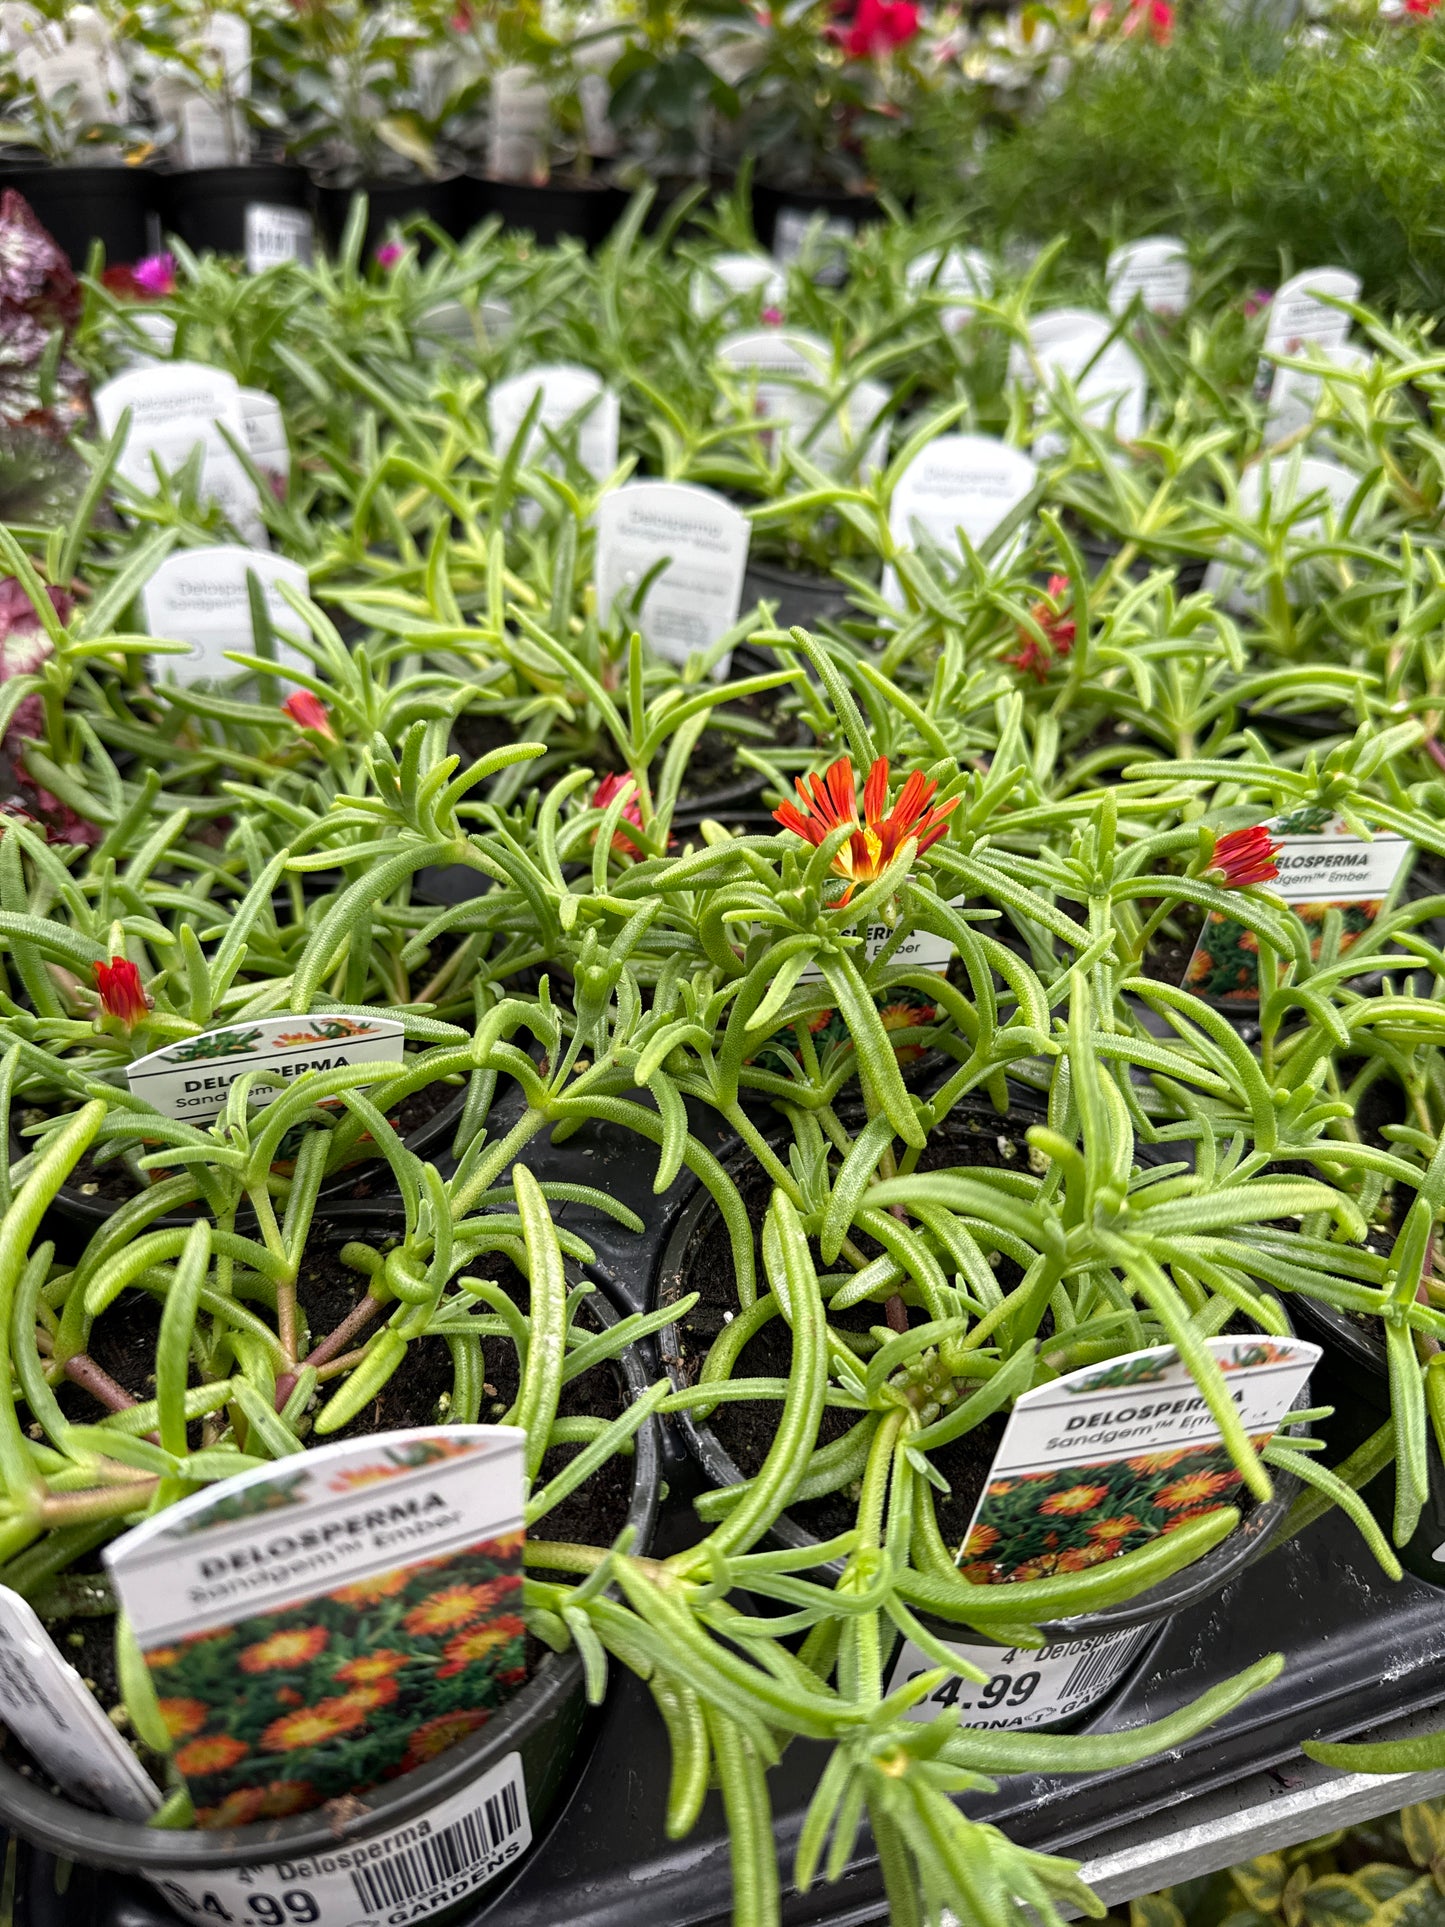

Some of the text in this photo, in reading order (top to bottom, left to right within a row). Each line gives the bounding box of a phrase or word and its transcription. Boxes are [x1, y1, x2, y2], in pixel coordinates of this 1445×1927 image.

[1274, 853, 1369, 869] ELOSPERMA
[1328, 871, 1369, 882] Ember
[873, 943, 921, 957] Eber
[1046, 1408, 1248, 1450] Sandgem™ Emr
[1064, 1389, 1245, 1431] DELOSPERA
[200, 1491, 447, 1580] DELOSPERMA
[371, 1509, 463, 1549] Ember
[274, 1819, 432, 1882] Delosperma
[160, 1879, 321, 1926] $4.99
[387, 1841, 521, 1926] GARDENS
